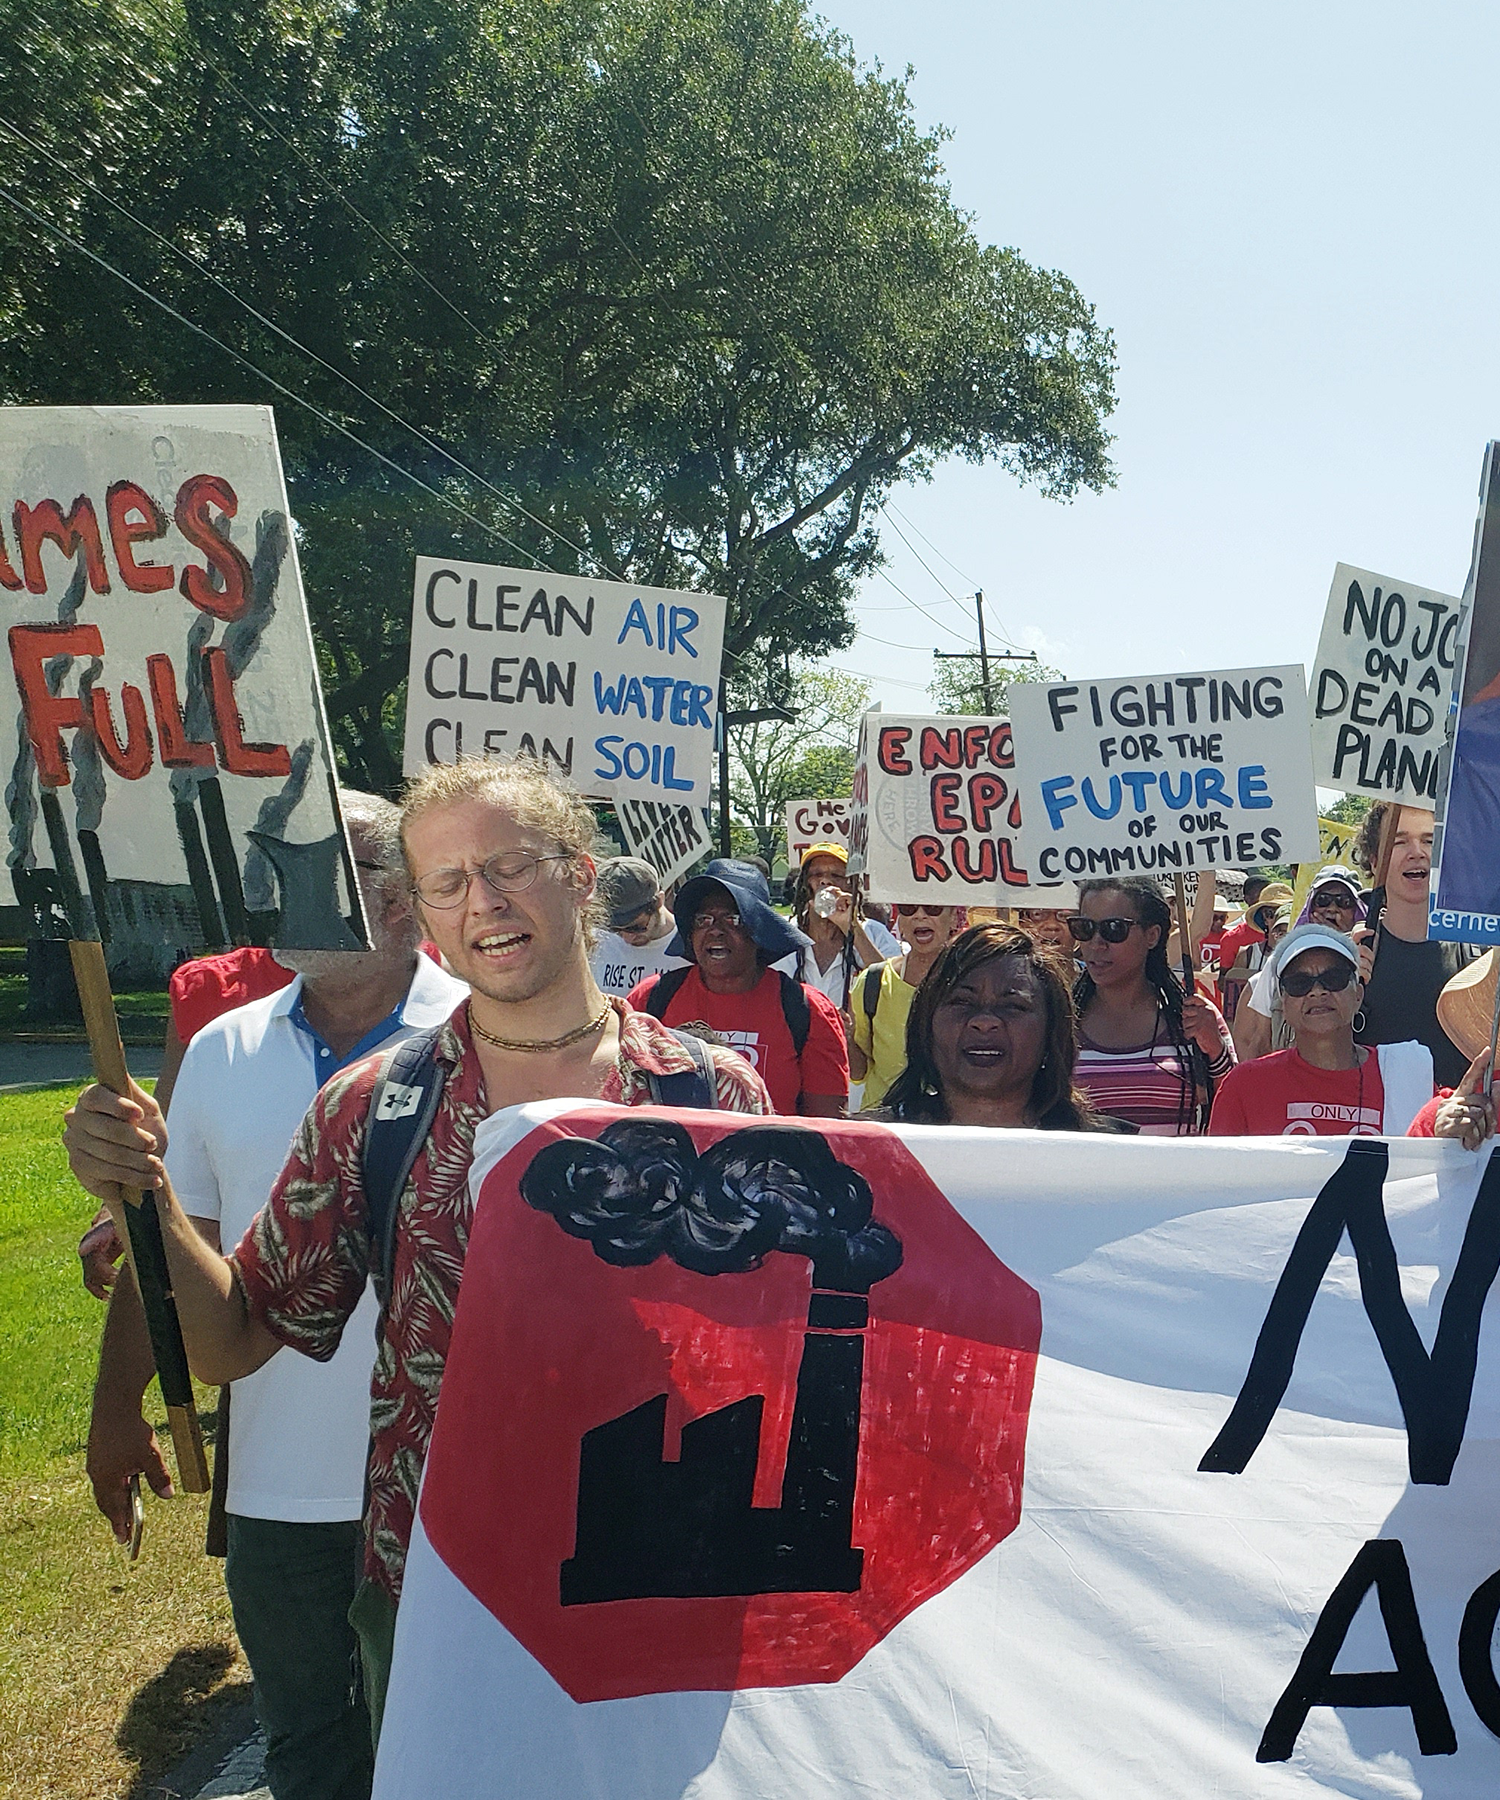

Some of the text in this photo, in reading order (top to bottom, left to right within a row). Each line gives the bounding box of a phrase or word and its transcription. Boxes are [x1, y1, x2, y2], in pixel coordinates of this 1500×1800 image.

[425, 569, 699, 659] CLEAN AIR
[1343, 580, 1406, 648] NO
[424, 648, 713, 729] CLEAN WATER
[1365, 648, 1441, 697] ON A
[1047, 677, 1284, 732] FIGHTING
[1315, 668, 1434, 735] DEAD
[425, 718, 695, 791] CLEAN SOIL
[1100, 733, 1223, 767] FOR THE
[1041, 765, 1273, 831] FUTURE
[1128, 812, 1228, 838] OF OUR
[1039, 827, 1282, 878] COMMUNITIES
[603, 964, 626, 987] RISE
[1311, 1104, 1357, 1121] ONLY
